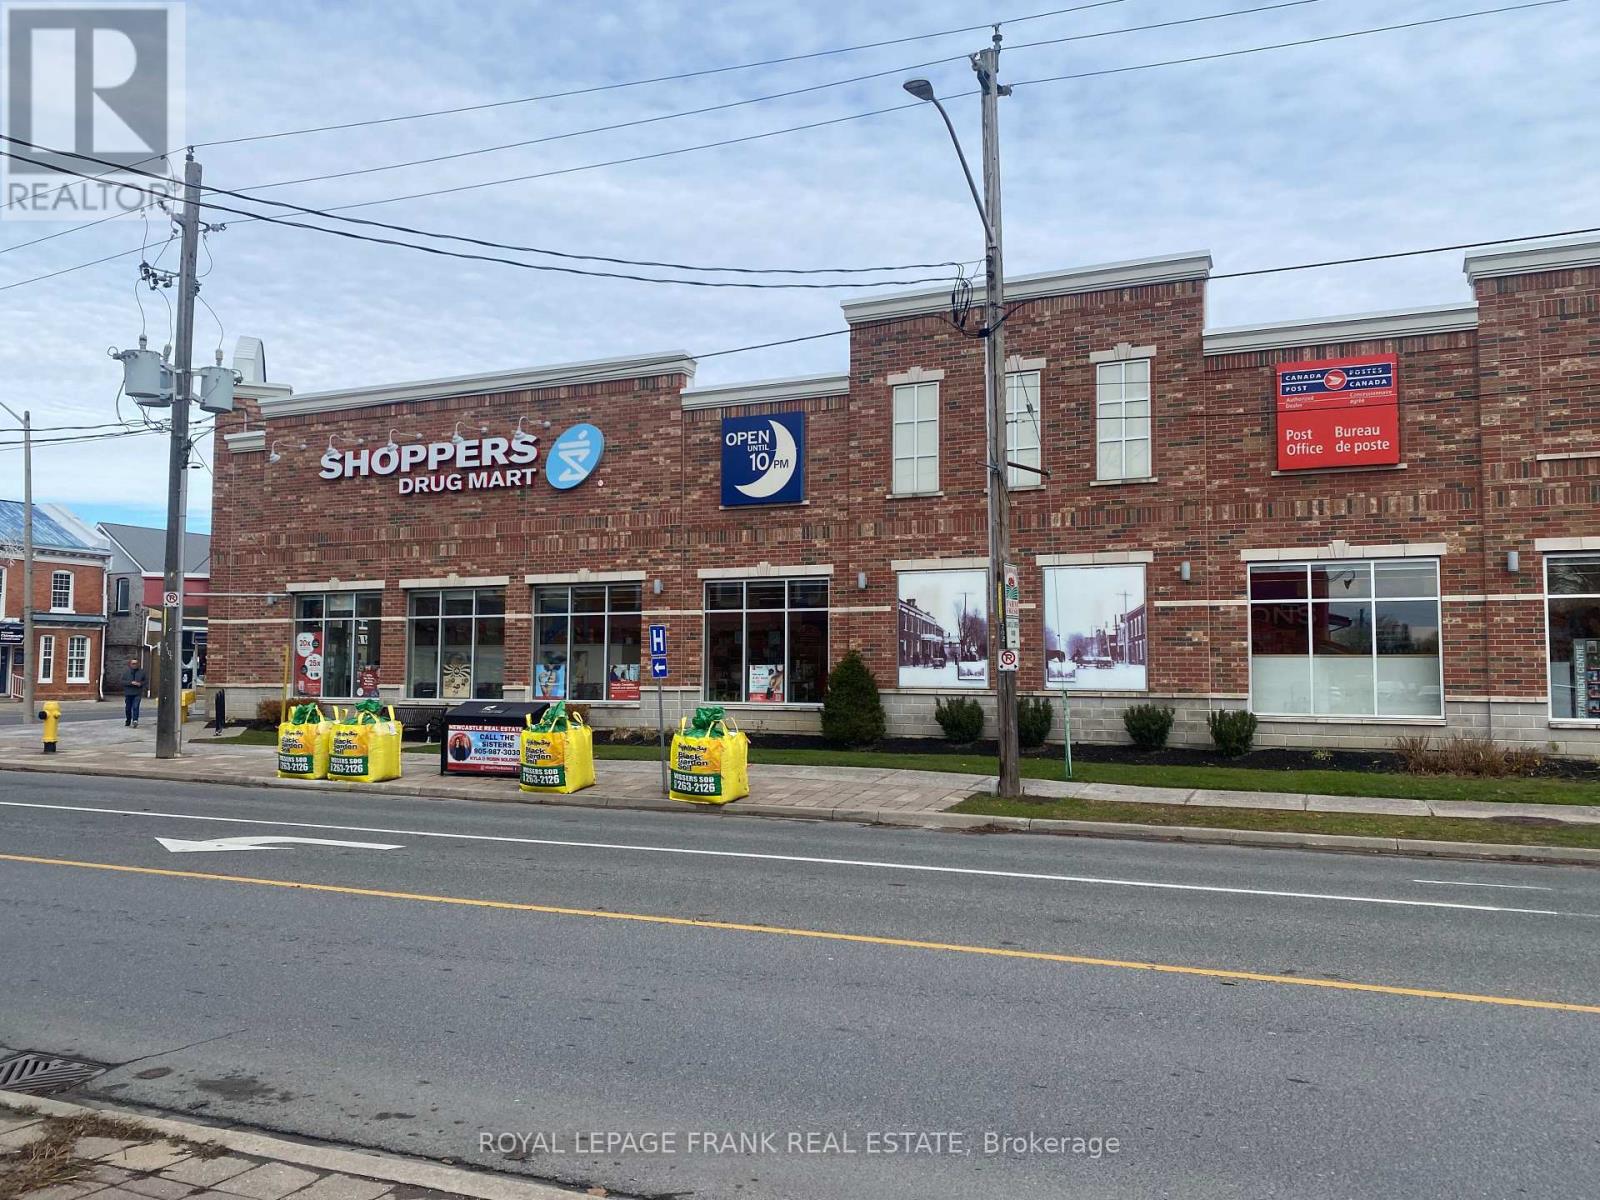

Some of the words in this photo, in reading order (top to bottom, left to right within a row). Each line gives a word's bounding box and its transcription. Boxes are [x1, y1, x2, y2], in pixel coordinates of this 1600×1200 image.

[1285, 373, 1322, 381] CANADA
[1349, 367, 1382, 375] POSTES
[1349, 379, 1387, 388] CANADA
[725, 429, 770, 446] OPEN
[1286, 429, 1313, 441] Post
[1335, 426, 1380, 438] Bureau
[747, 444, 770, 452] UNTIL
[1286, 443, 1324, 456] Office
[1335, 441, 1351, 453] de
[1354, 440, 1390, 454] poste
[318, 434, 539, 479] SHOPPERS
[749, 452, 770, 471] 10
[773, 459, 789, 469] PM
[399, 473, 462, 495] DRUG
[468, 467, 537, 489] MART
[652, 629, 664, 652] H
[677, 780, 716, 793] 263-2126
